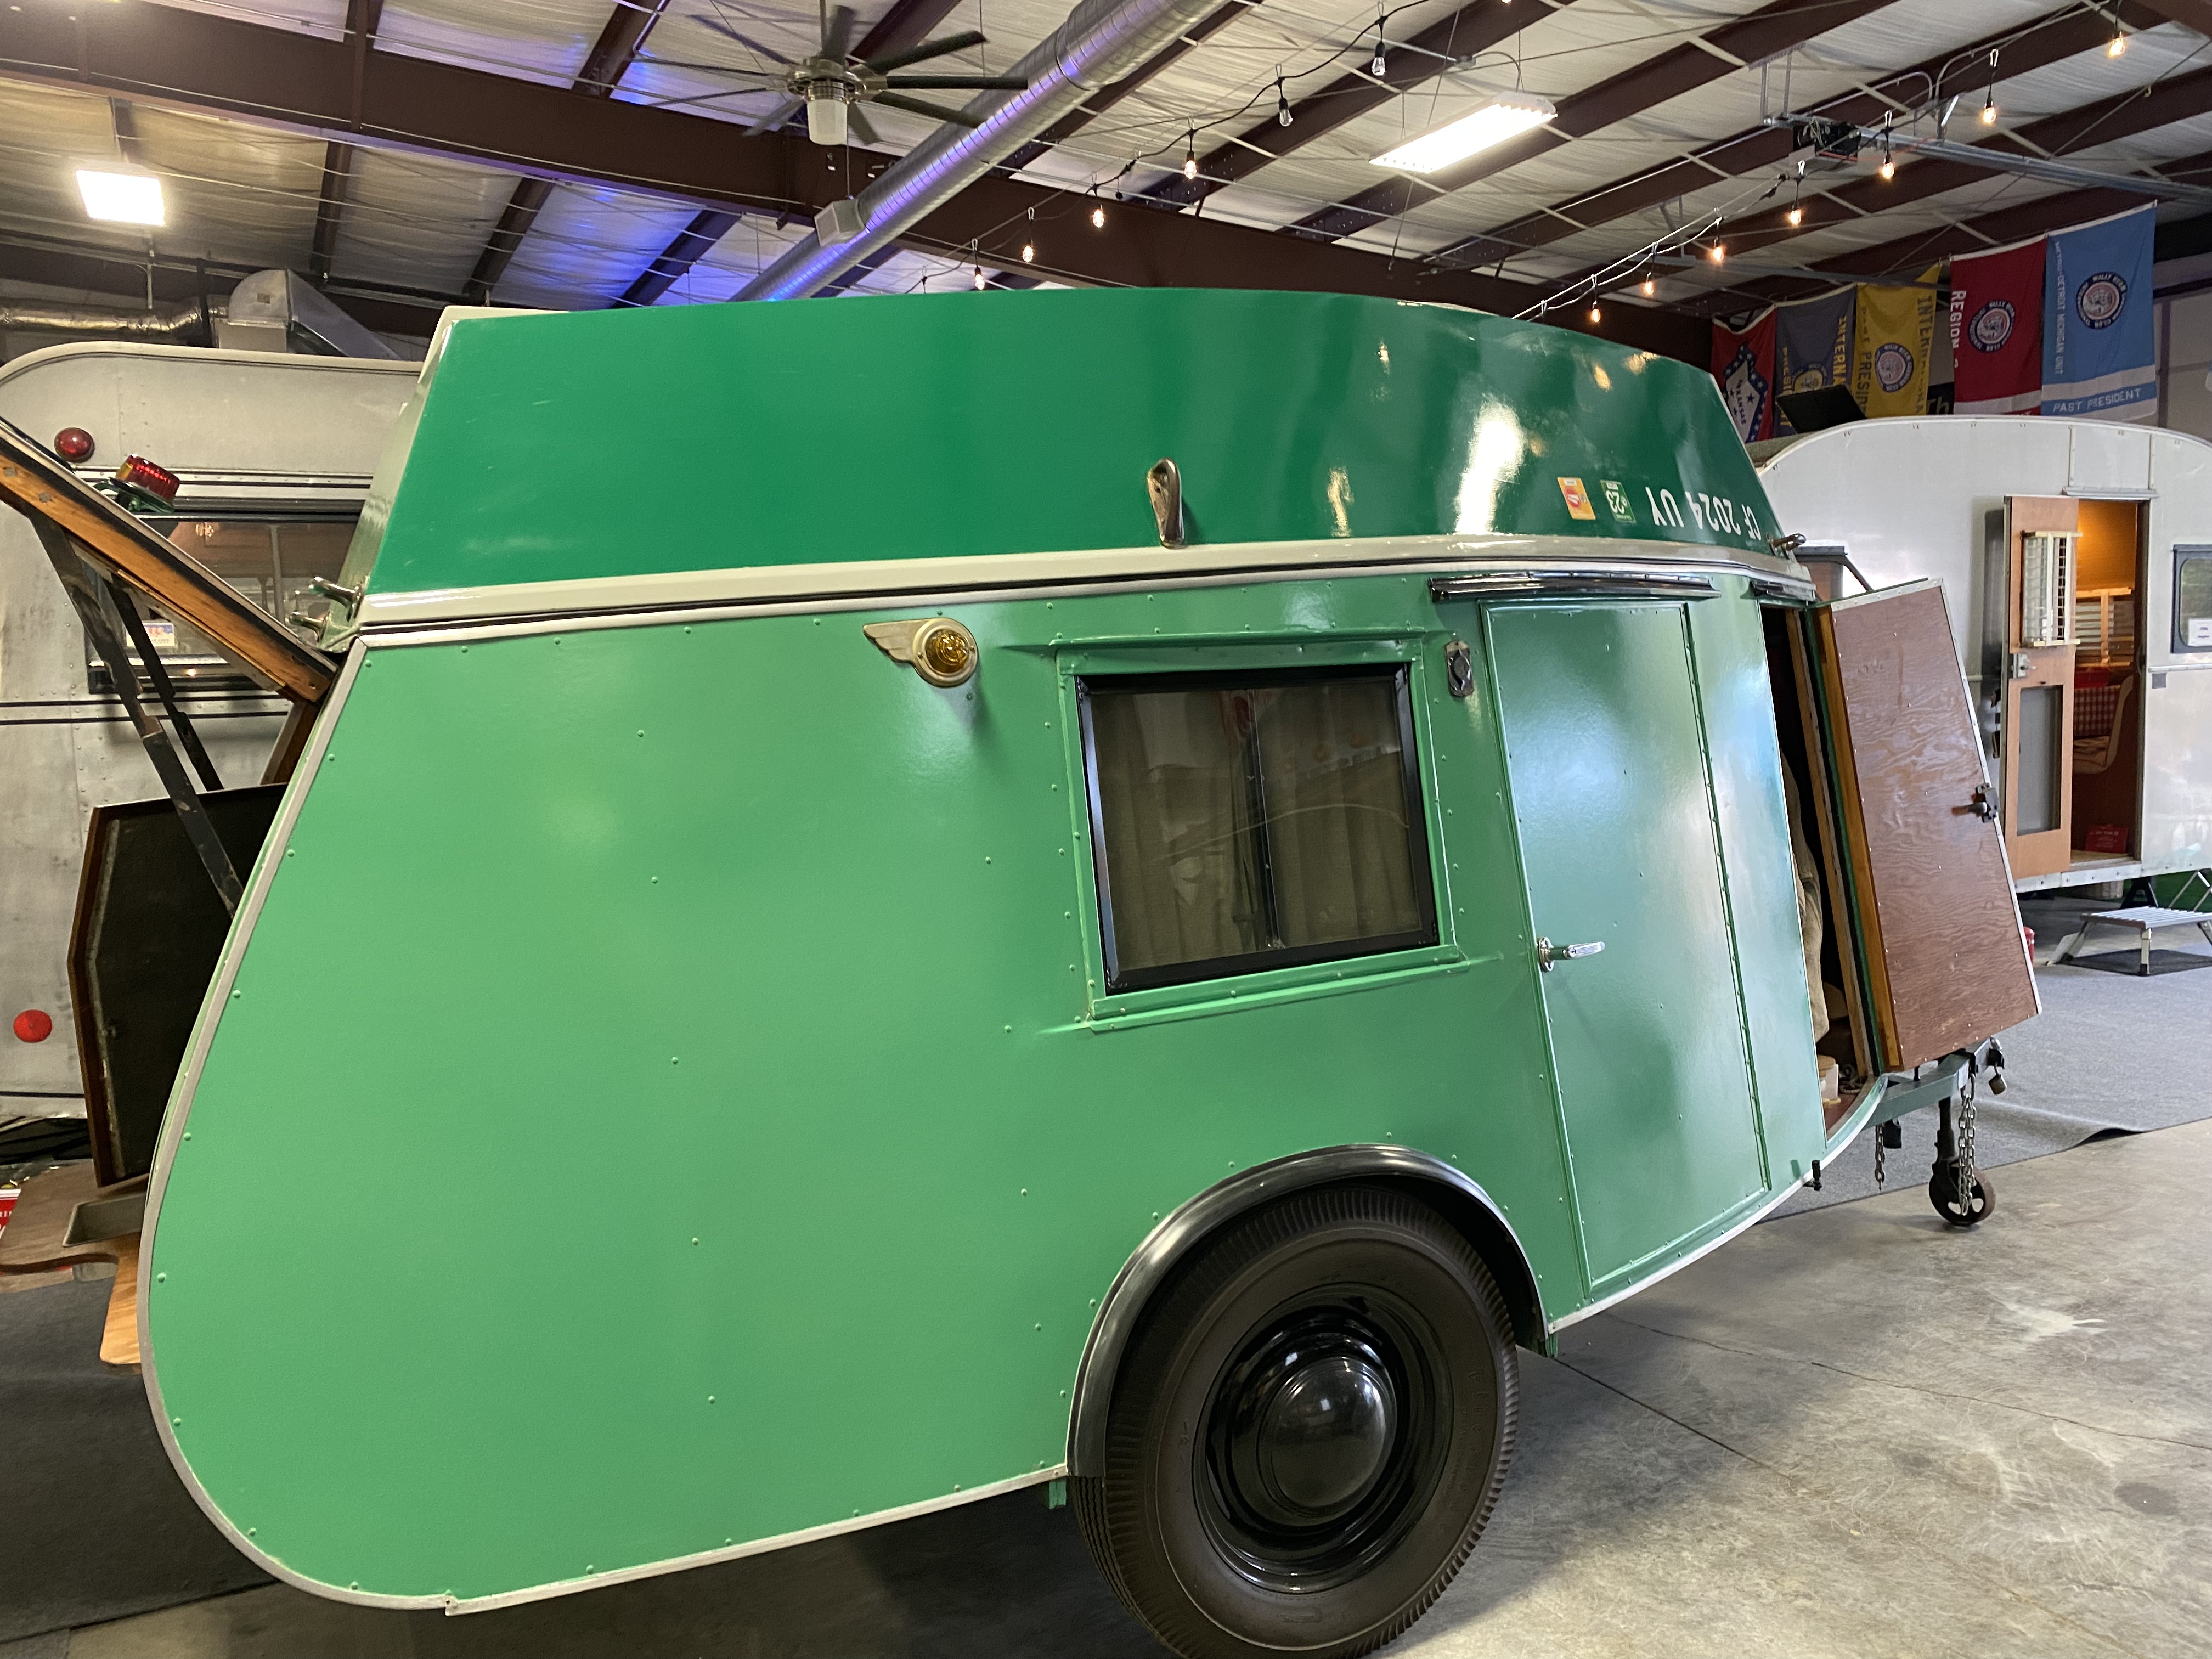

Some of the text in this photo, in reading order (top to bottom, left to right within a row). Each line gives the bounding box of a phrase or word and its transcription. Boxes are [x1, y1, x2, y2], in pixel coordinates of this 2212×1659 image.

[1950, 290, 1967, 349] REGION
[2055, 241, 2066, 374] METRO-DETROIT MICHIGAN UNIT
[2053, 387, 2142, 412] PAST PRESIDENT
[1606, 490, 1625, 514] 23
[1645, 486, 1762, 541] CF 2024 UY
